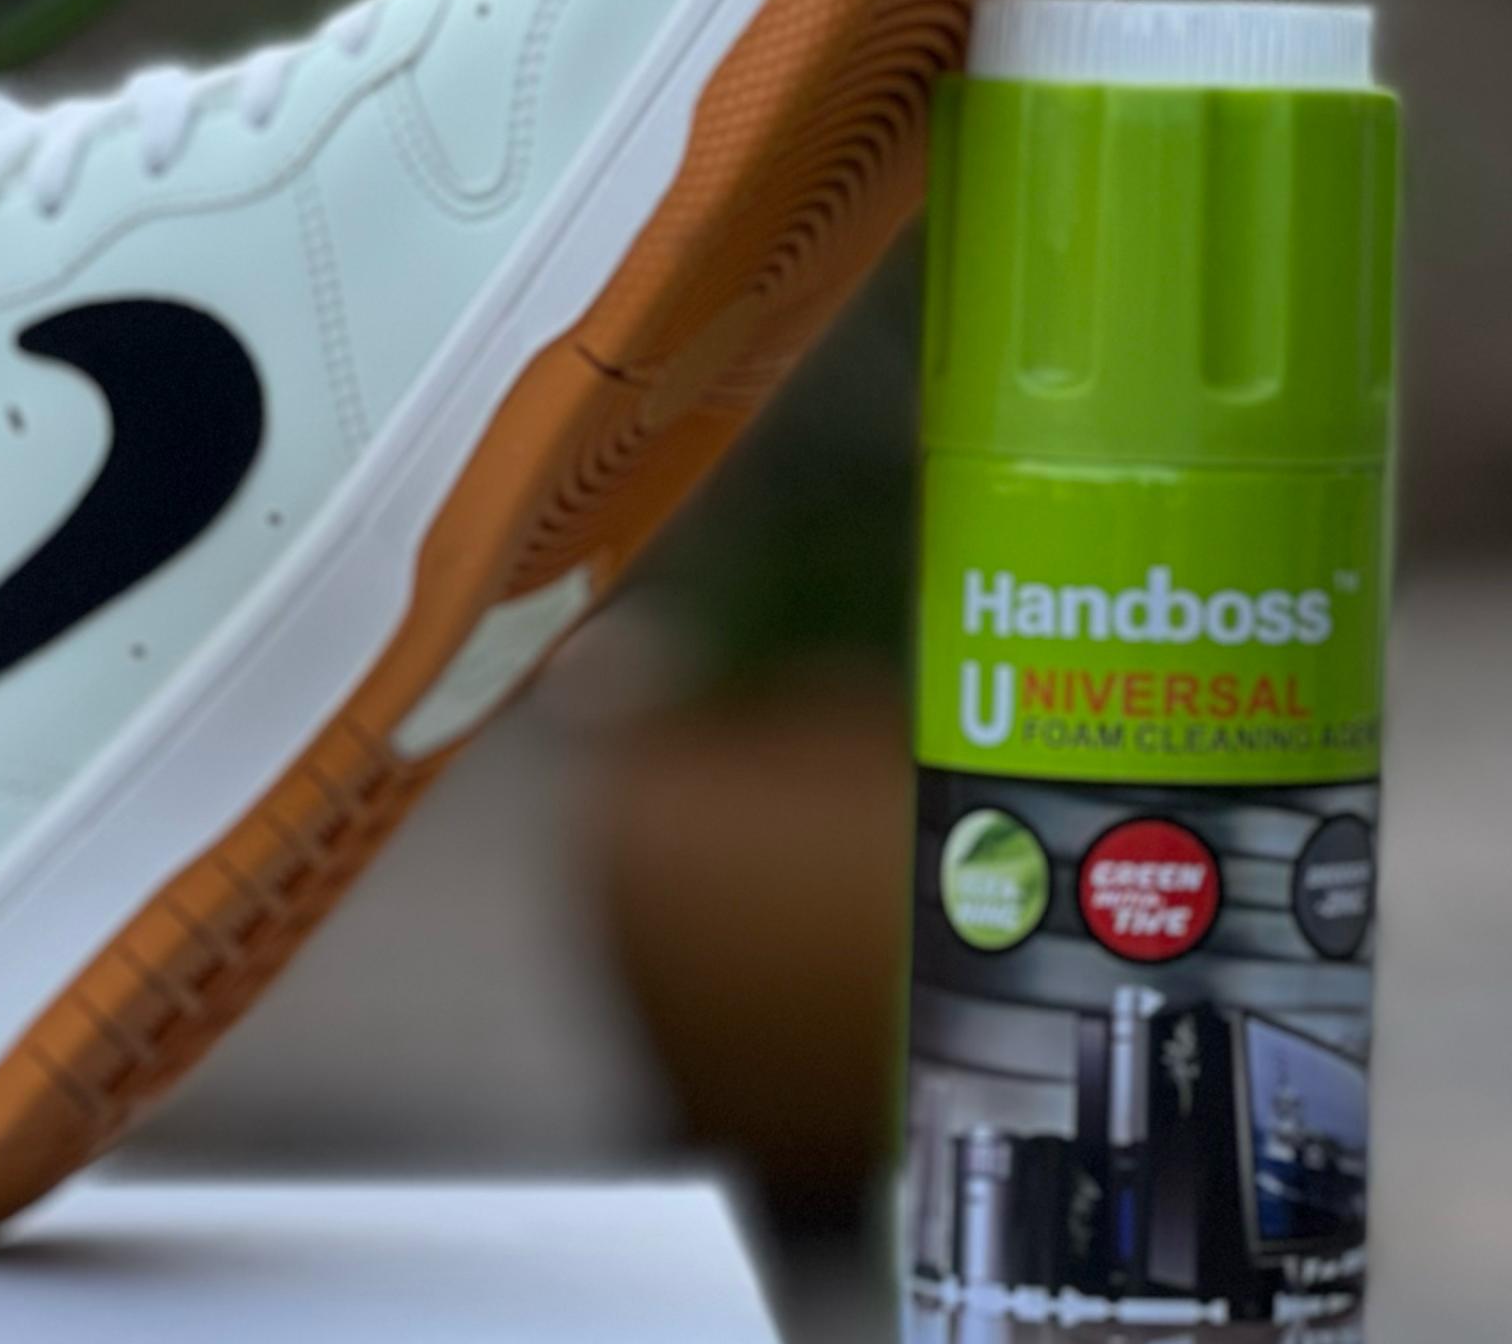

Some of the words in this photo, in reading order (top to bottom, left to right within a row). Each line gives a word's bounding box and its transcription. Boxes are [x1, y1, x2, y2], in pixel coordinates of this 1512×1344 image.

[962, 565, 1333, 646] Handboss
[1023, 719, 1124, 752] FOAM
[1135, 724, 1311, 755] CLEANING
